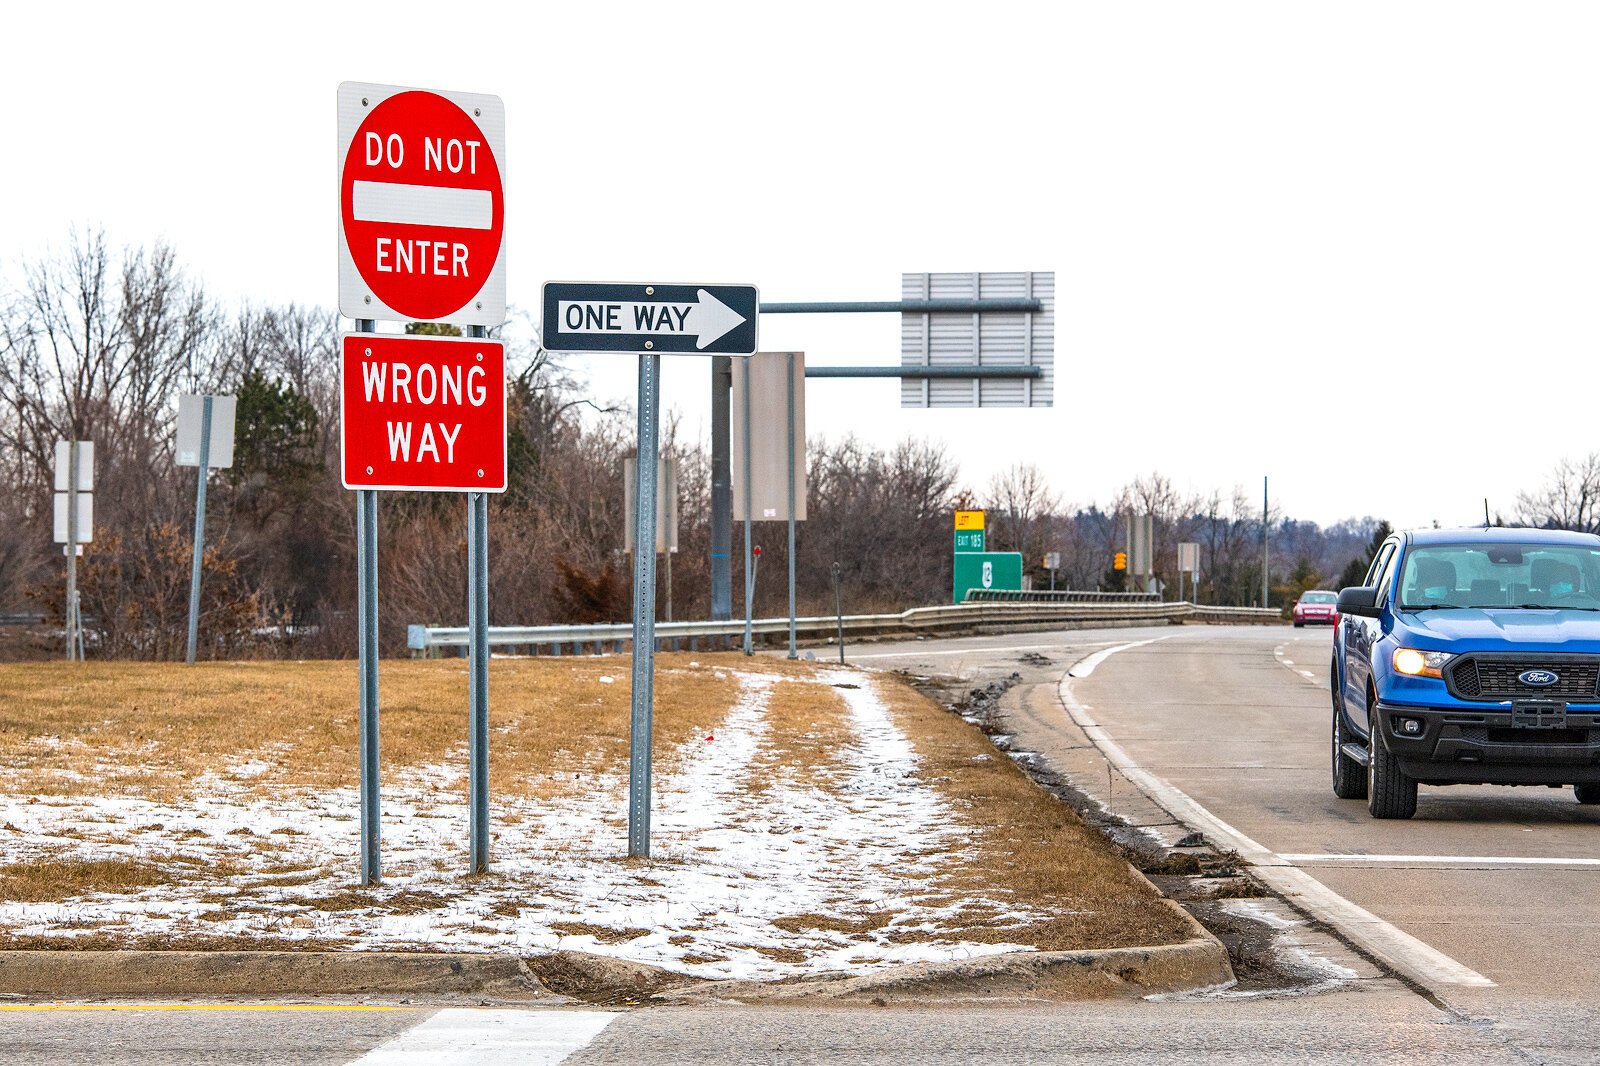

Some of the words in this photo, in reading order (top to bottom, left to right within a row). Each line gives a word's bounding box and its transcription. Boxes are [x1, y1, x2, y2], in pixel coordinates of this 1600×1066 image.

[366, 132, 404, 168] DO
[425, 137, 481, 174] NOT
[376, 237, 470, 278] ENTER
[565, 303, 622, 331] ONE
[633, 305, 693, 332] WAY
[361, 361, 488, 407] WRONG
[386, 421, 463, 464] WAY
[958, 535, 969, 546] EXIT
[1527, 672, 1550, 682] Ford
